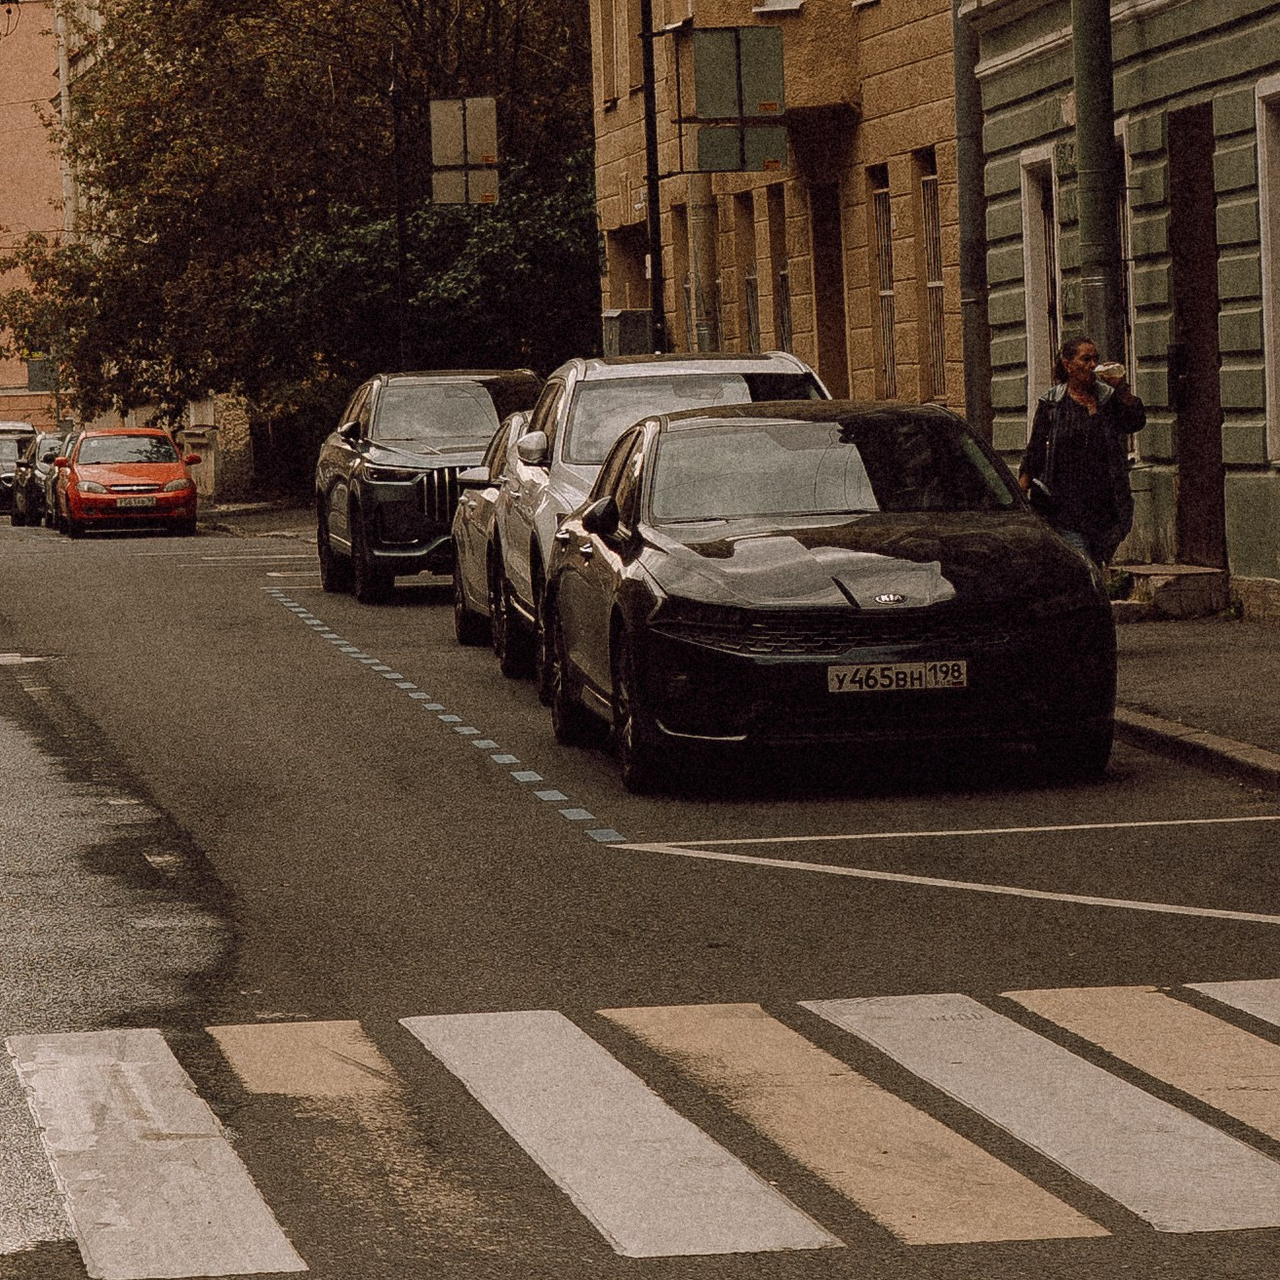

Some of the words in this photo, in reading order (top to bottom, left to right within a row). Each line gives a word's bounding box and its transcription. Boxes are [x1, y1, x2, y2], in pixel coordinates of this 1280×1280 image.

[880, 593, 903, 602] KIA
[835, 666, 923, 690] У465ВН
[927, 662, 962, 681] 198
